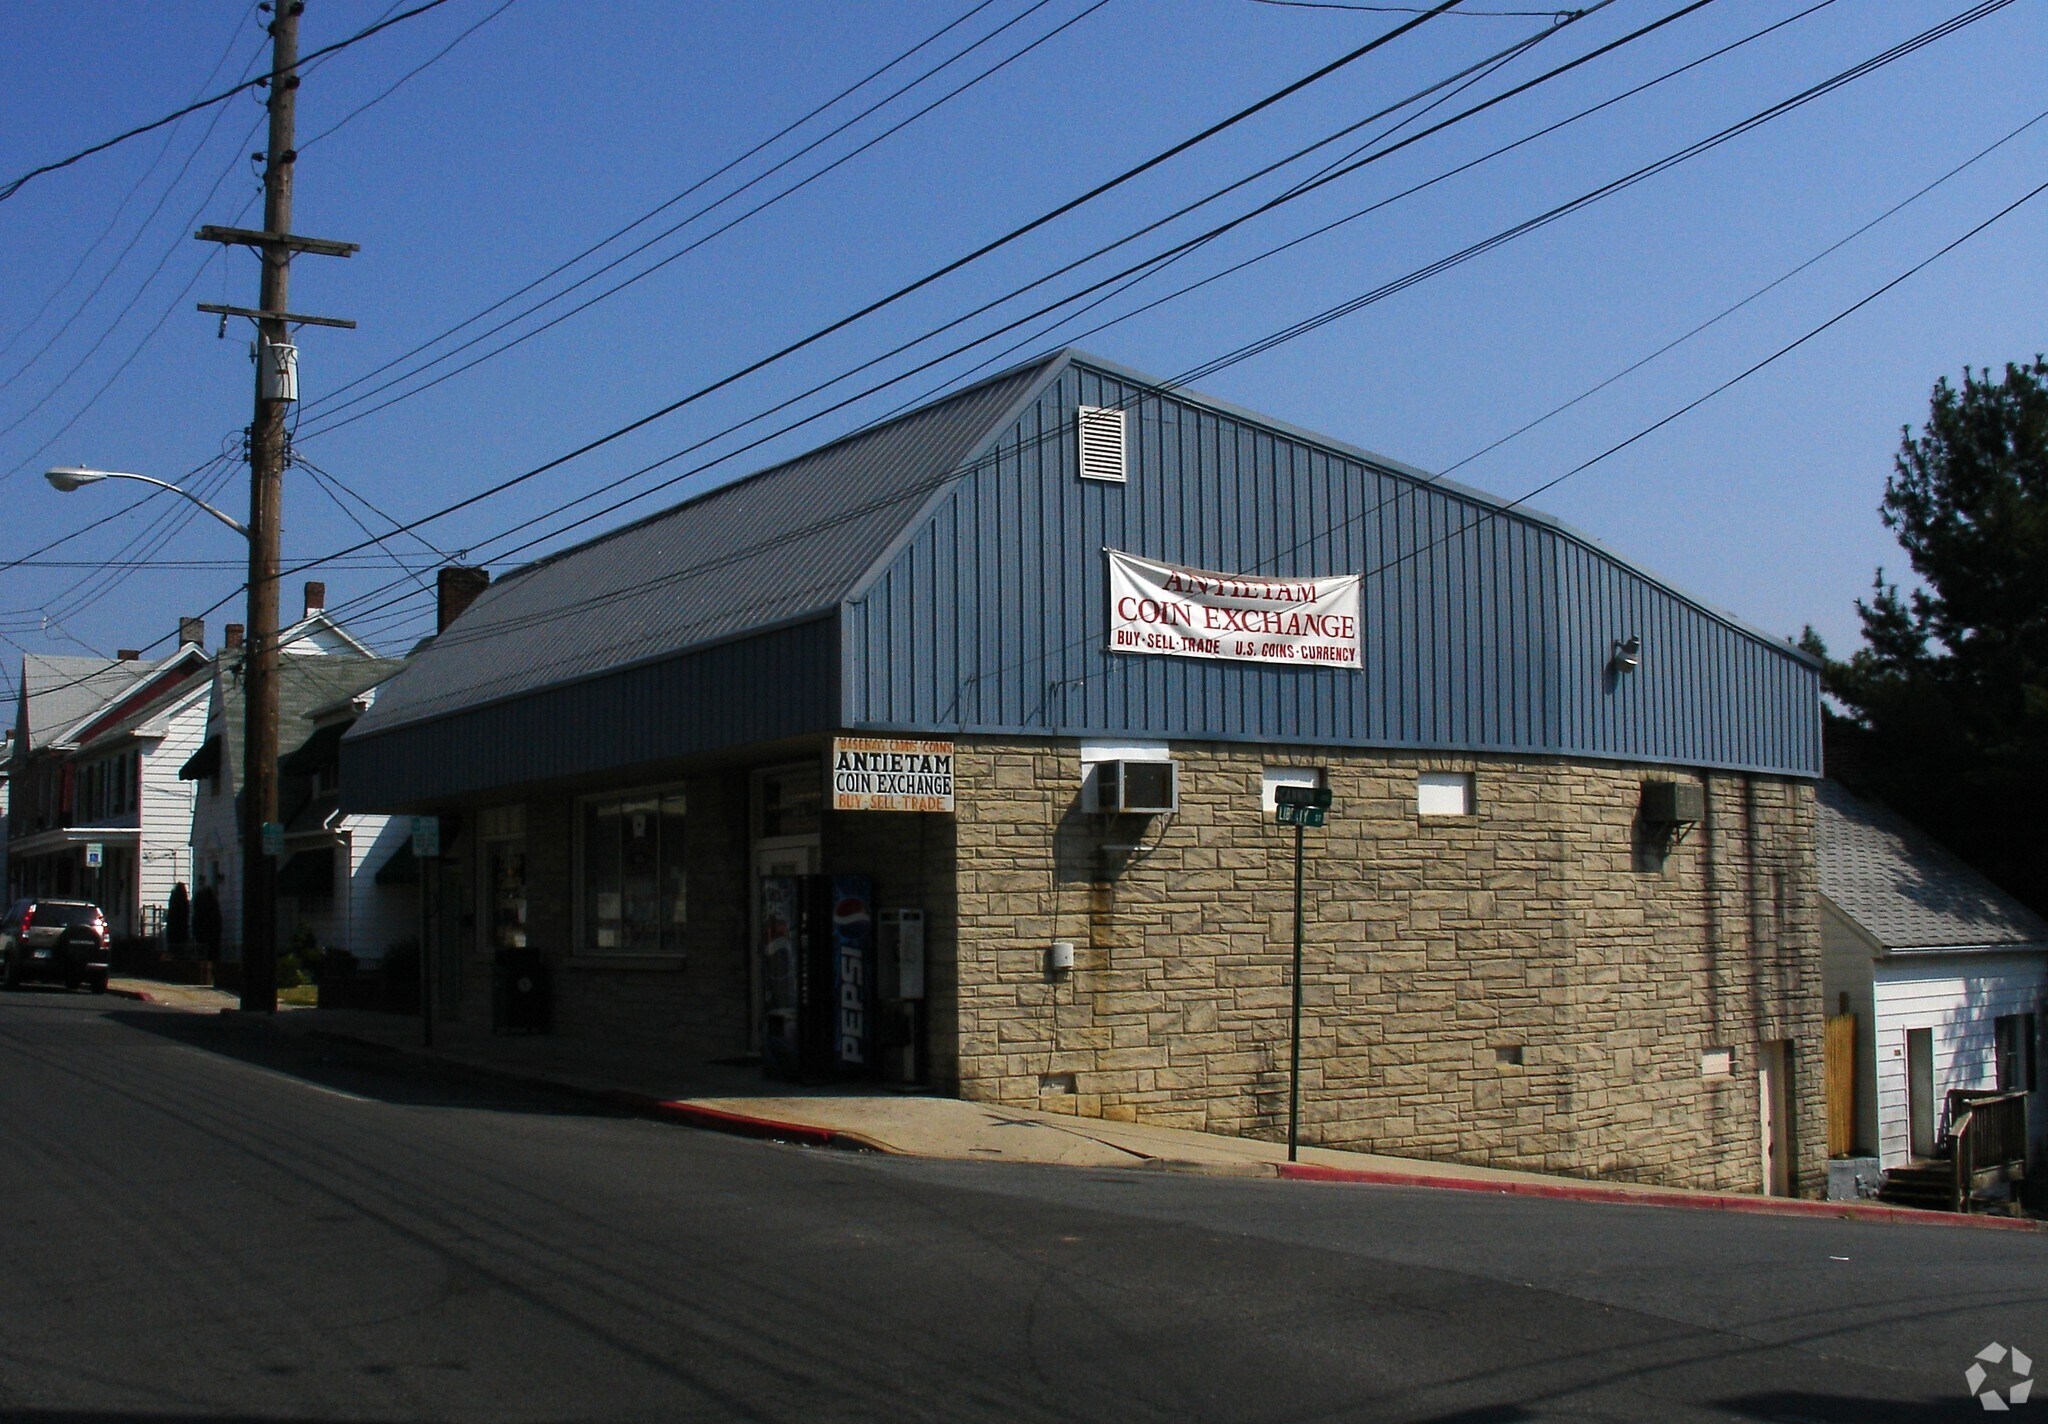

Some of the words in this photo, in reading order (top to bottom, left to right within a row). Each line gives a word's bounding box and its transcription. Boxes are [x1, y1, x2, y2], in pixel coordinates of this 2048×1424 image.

[1162, 570, 1317, 604] ANTIETAM
[1117, 596, 1191, 627] COIN
[1203, 604, 1355, 639] EXCHANGE
[1117, 630, 1140, 646] BUY
[1147, 633, 1175, 650] SELL
[1181, 636, 1220, 654] TRADE
[1235, 641, 1257, 656] U.S.
[1261, 643, 1295, 659] COINS
[1301, 645, 1355, 661] CURRENCY
[922, 742, 953, 754] COINS
[836, 752, 951, 774] ANTIETAM
[836, 773, 871, 793] COIN
[877, 774, 951, 795] EXCHANGE
[838, 794, 862, 809] BUY
[870, 795, 896, 810] SELL
[902, 796, 946, 811] TRADE
[841, 946, 864, 1064] PEPSI
